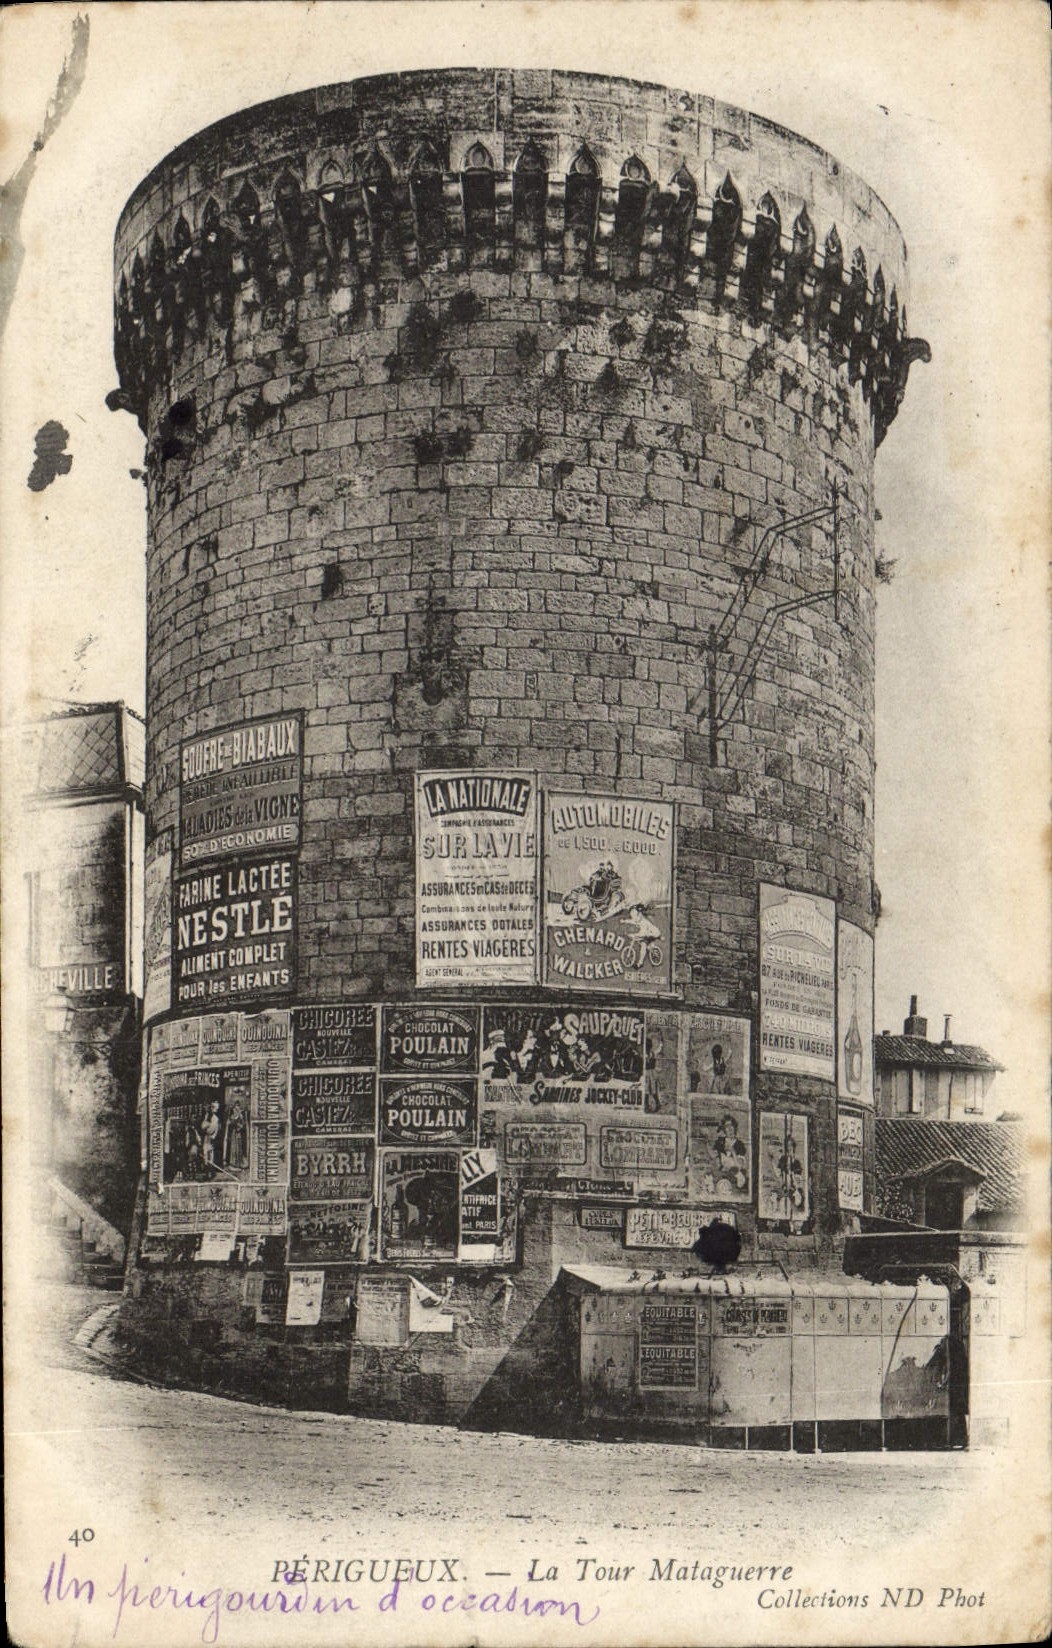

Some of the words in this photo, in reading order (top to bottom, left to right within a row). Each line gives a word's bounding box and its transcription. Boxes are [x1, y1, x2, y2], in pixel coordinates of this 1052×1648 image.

[182, 738, 223, 782] SOUFRE
[232, 719, 296, 766] BIABAUX
[254, 793, 299, 822] VIGNE
[425, 783, 448, 813] LA
[447, 779, 530, 812] NATIONALE
[552, 801, 671, 841] AUTOMOBILES
[423, 833, 467, 859] SUR
[472, 832, 499, 858] LA
[502, 832, 536, 858] VIE
[180, 874, 222, 909] FARINE
[228, 860, 291, 896] LACTÉE
[421, 881, 476, 896] ASSURANCES
[484, 881, 501, 895] CAS
[177, 890, 293, 951] NESTLÉ
[422, 919, 487, 932] ASSURANCES
[492, 919, 534, 931] DOTALES
[422, 940, 469, 960] RENTES
[553, 926, 626, 952] CHENARD
[181, 950, 226, 977] ALIMENT
[228, 942, 286, 967] COMPLET
[552, 953, 624, 980] WALCKER
[179, 981, 205, 1001] POUR
[208, 979, 226, 995] les
[230, 968, 290, 991] ENFANTS
[764, 998, 789, 1010] FONDS
[242, 1023, 287, 1043] QUINQUINA
[404, 1022, 454, 1034] CHOCOLAT
[563, 1012, 644, 1045] SAUPIQUET
[762, 1032, 795, 1050] RENTES
[390, 1036, 469, 1055] POULAIN
[267, 1060, 281, 1120] QUINQUINA
[402, 1094, 452, 1106] CHOCOLAT
[530, 1079, 583, 1105] SARDINES
[585, 1087, 643, 1106] JOCKEY-CLUB
[387, 1109, 467, 1128] POULAIN
[267, 1123, 281, 1183] QUINQUINA
[296, 1151, 366, 1176] BYRRH
[240, 1198, 285, 1216] QUINQUINA
[462, 1194, 497, 1206] NTIFRICE
[475, 1221, 497, 1230] PARIS
[645, 1306, 695, 1318] EQUITABLE
[41, 1552, 95, 1605] Un
